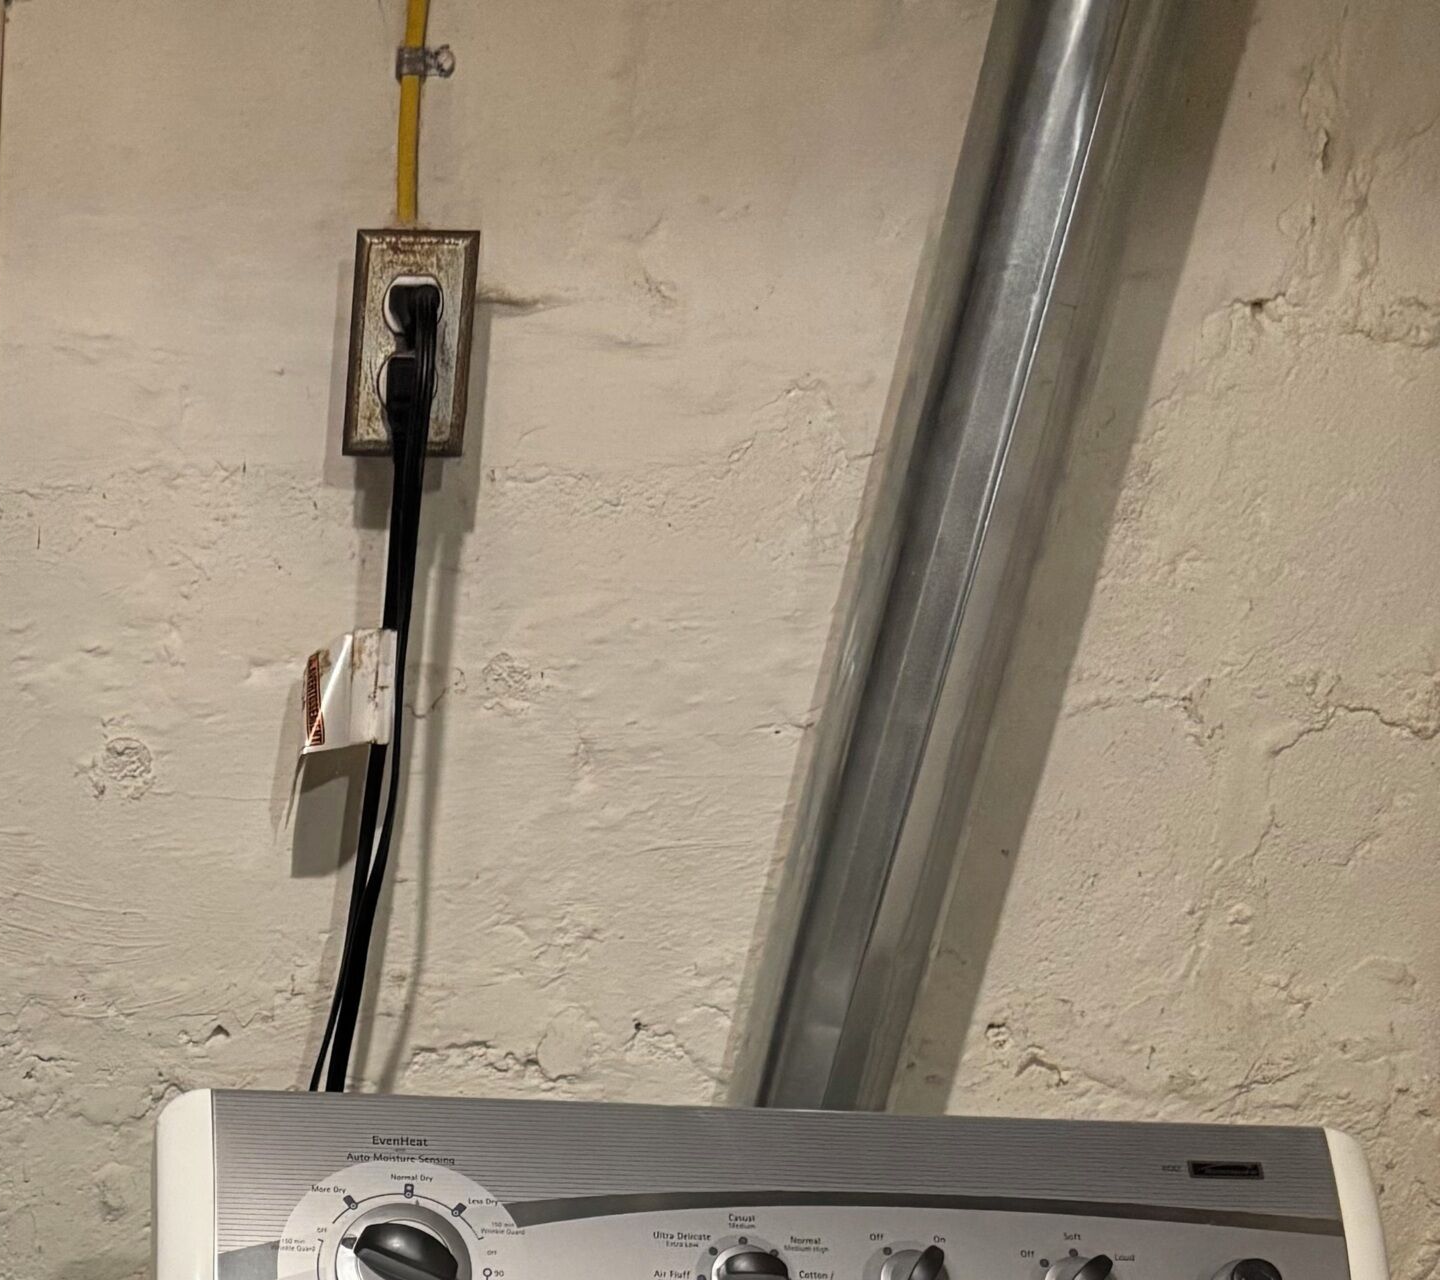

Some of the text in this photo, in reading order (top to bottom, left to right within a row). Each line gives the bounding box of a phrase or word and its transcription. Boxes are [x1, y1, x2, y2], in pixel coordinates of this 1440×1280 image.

[372, 1135, 429, 1147] EvenHeat
[346, 1152, 456, 1165] Auto Moisture Sensing
[390, 1173, 434, 1183] Normal Dry
[311, 1184, 347, 1194] More Dry
[468, 1197, 498, 1207] Less Dry
[728, 1213, 756, 1223] Casual
[653, 1231, 711, 1242] Ultra Delicate
[790, 1235, 821, 1246] Normal
[869, 1232, 884, 1241] Off
[933, 1234, 946, 1244] On
[1063, 1232, 1081, 1241] Soft
[1020, 1249, 1035, 1259] Off
[1114, 1252, 1136, 1262] Loud
[493, 1269, 505, 1278] 90
[653, 1270, 691, 1280] Air Fluff
[799, 1270, 828, 1280] Cotton
